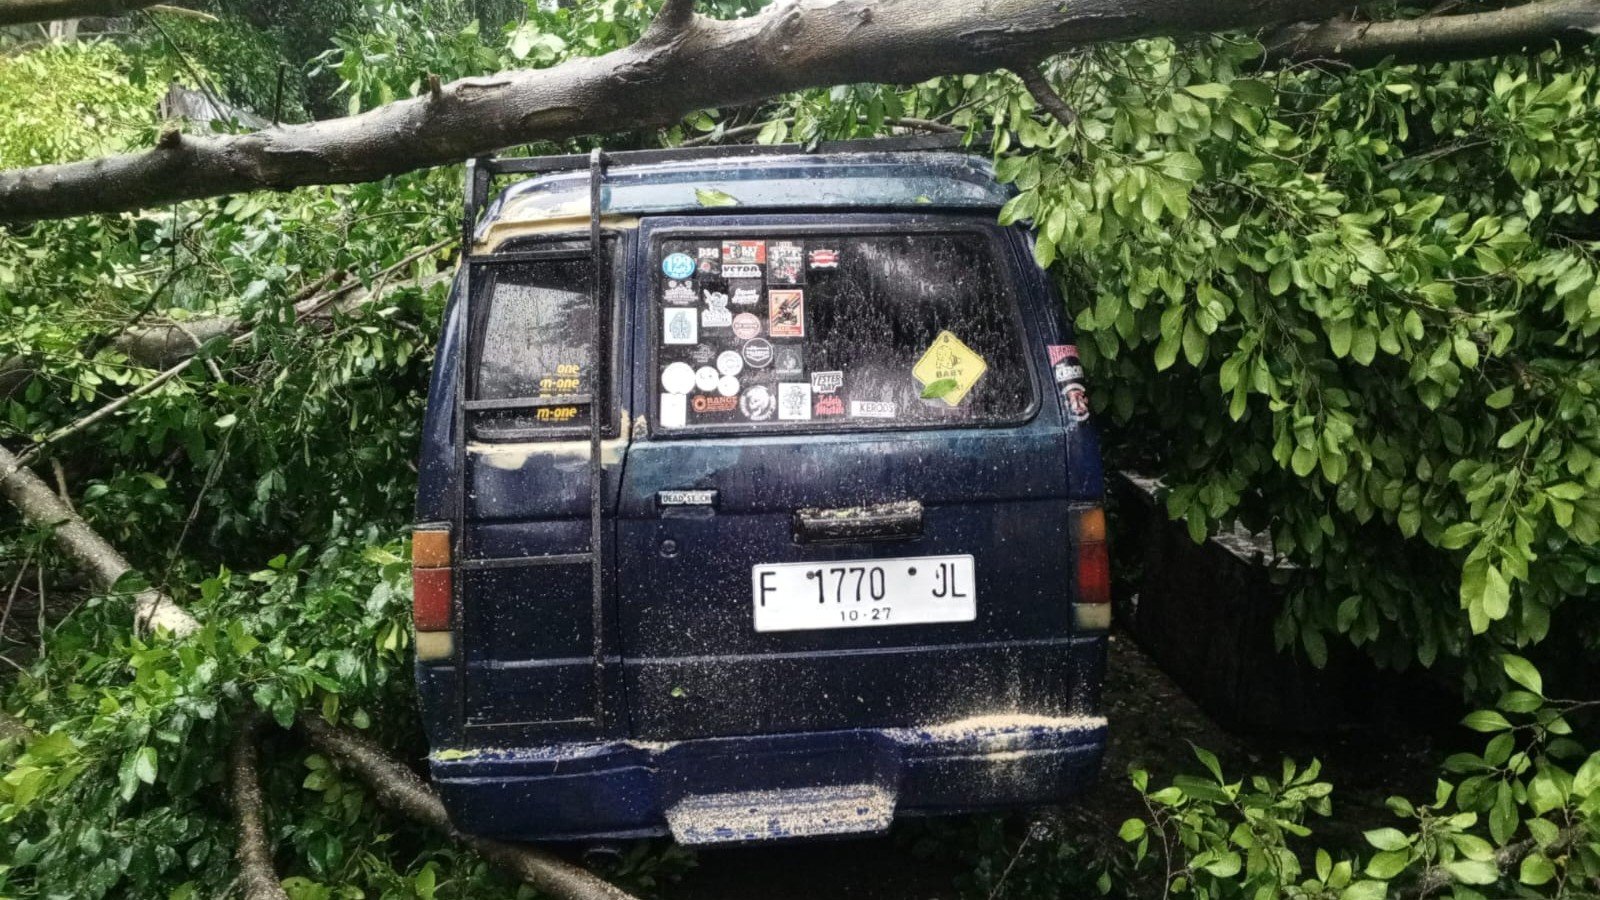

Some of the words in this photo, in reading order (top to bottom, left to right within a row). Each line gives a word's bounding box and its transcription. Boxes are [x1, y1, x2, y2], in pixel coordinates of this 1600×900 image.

[557, 364, 580, 374] one
[936, 370, 963, 378] BABY
[536, 407, 578, 419] m-one
[663, 494, 683, 502] DEAD
[760, 571, 777, 606] F
[813, 566, 885, 604] 1770
[932, 563, 967, 598] JL
